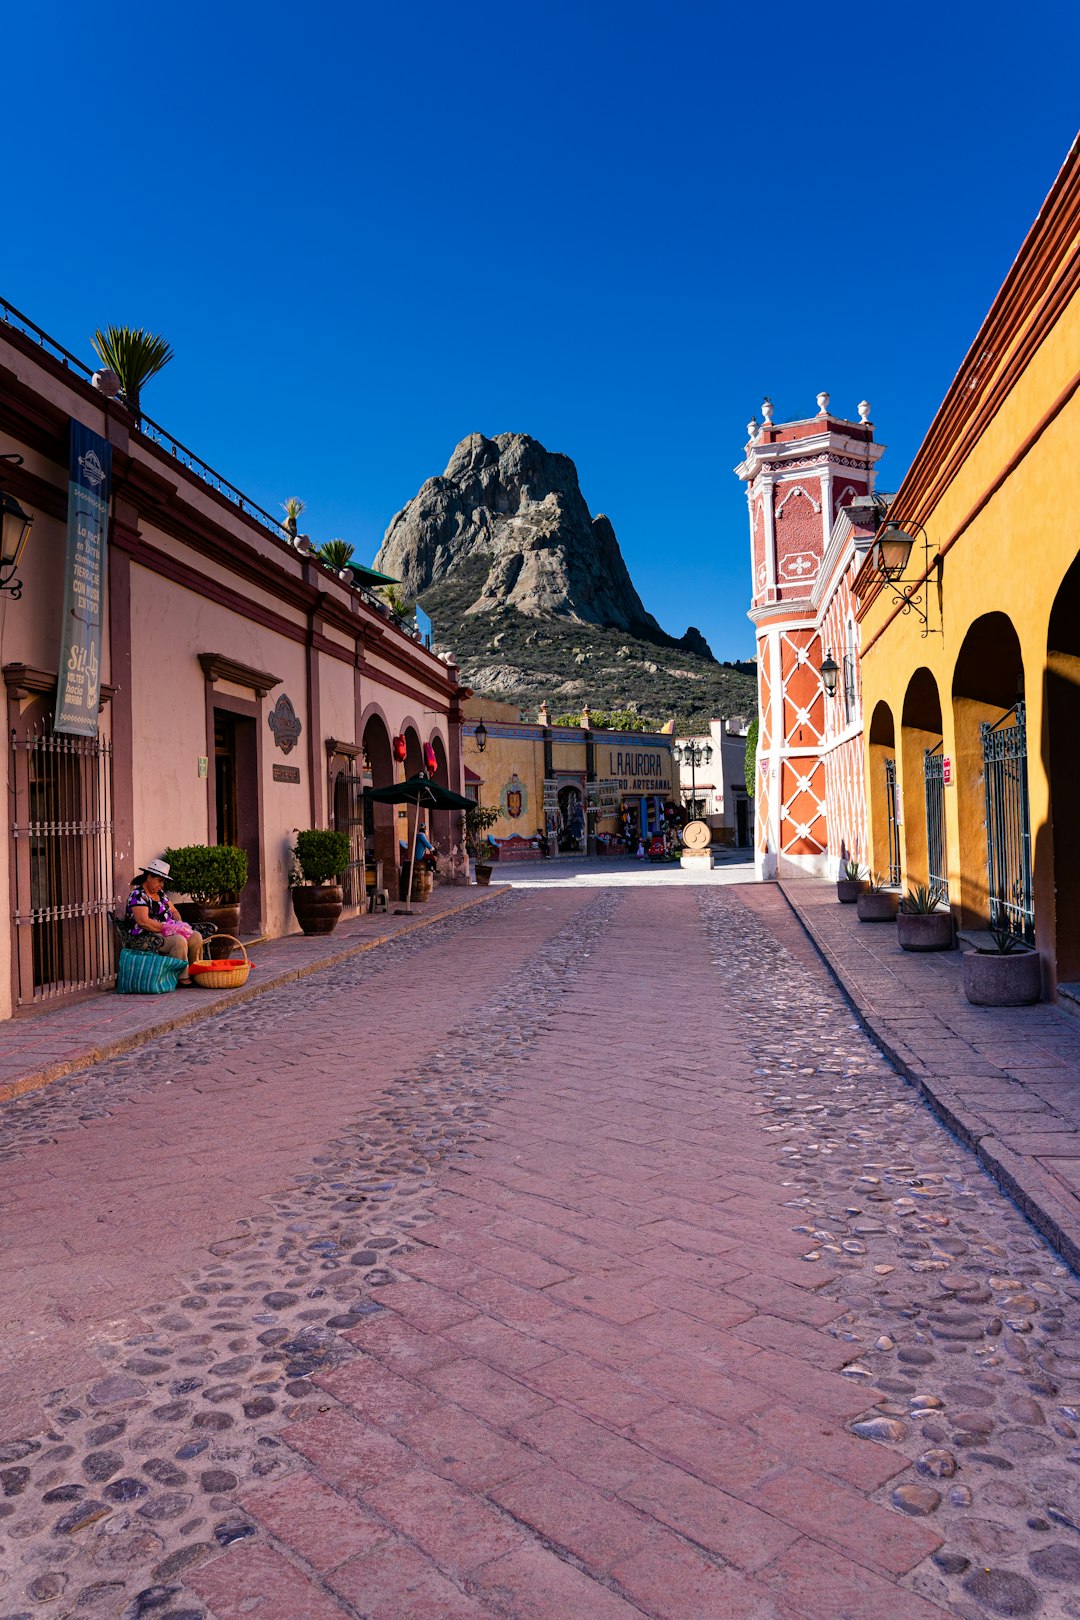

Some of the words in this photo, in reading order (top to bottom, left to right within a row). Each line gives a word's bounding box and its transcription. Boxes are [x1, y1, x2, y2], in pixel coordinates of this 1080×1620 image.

[78, 523, 87, 537] La
[77, 542, 84, 551] en
[73, 579, 86, 595] CON
[65, 682, 83, 696] hacia
[65, 693, 82, 706] ARRIBA
[624, 752, 662, 777] AURORA
[633, 779, 671, 791] ARTESANAL
